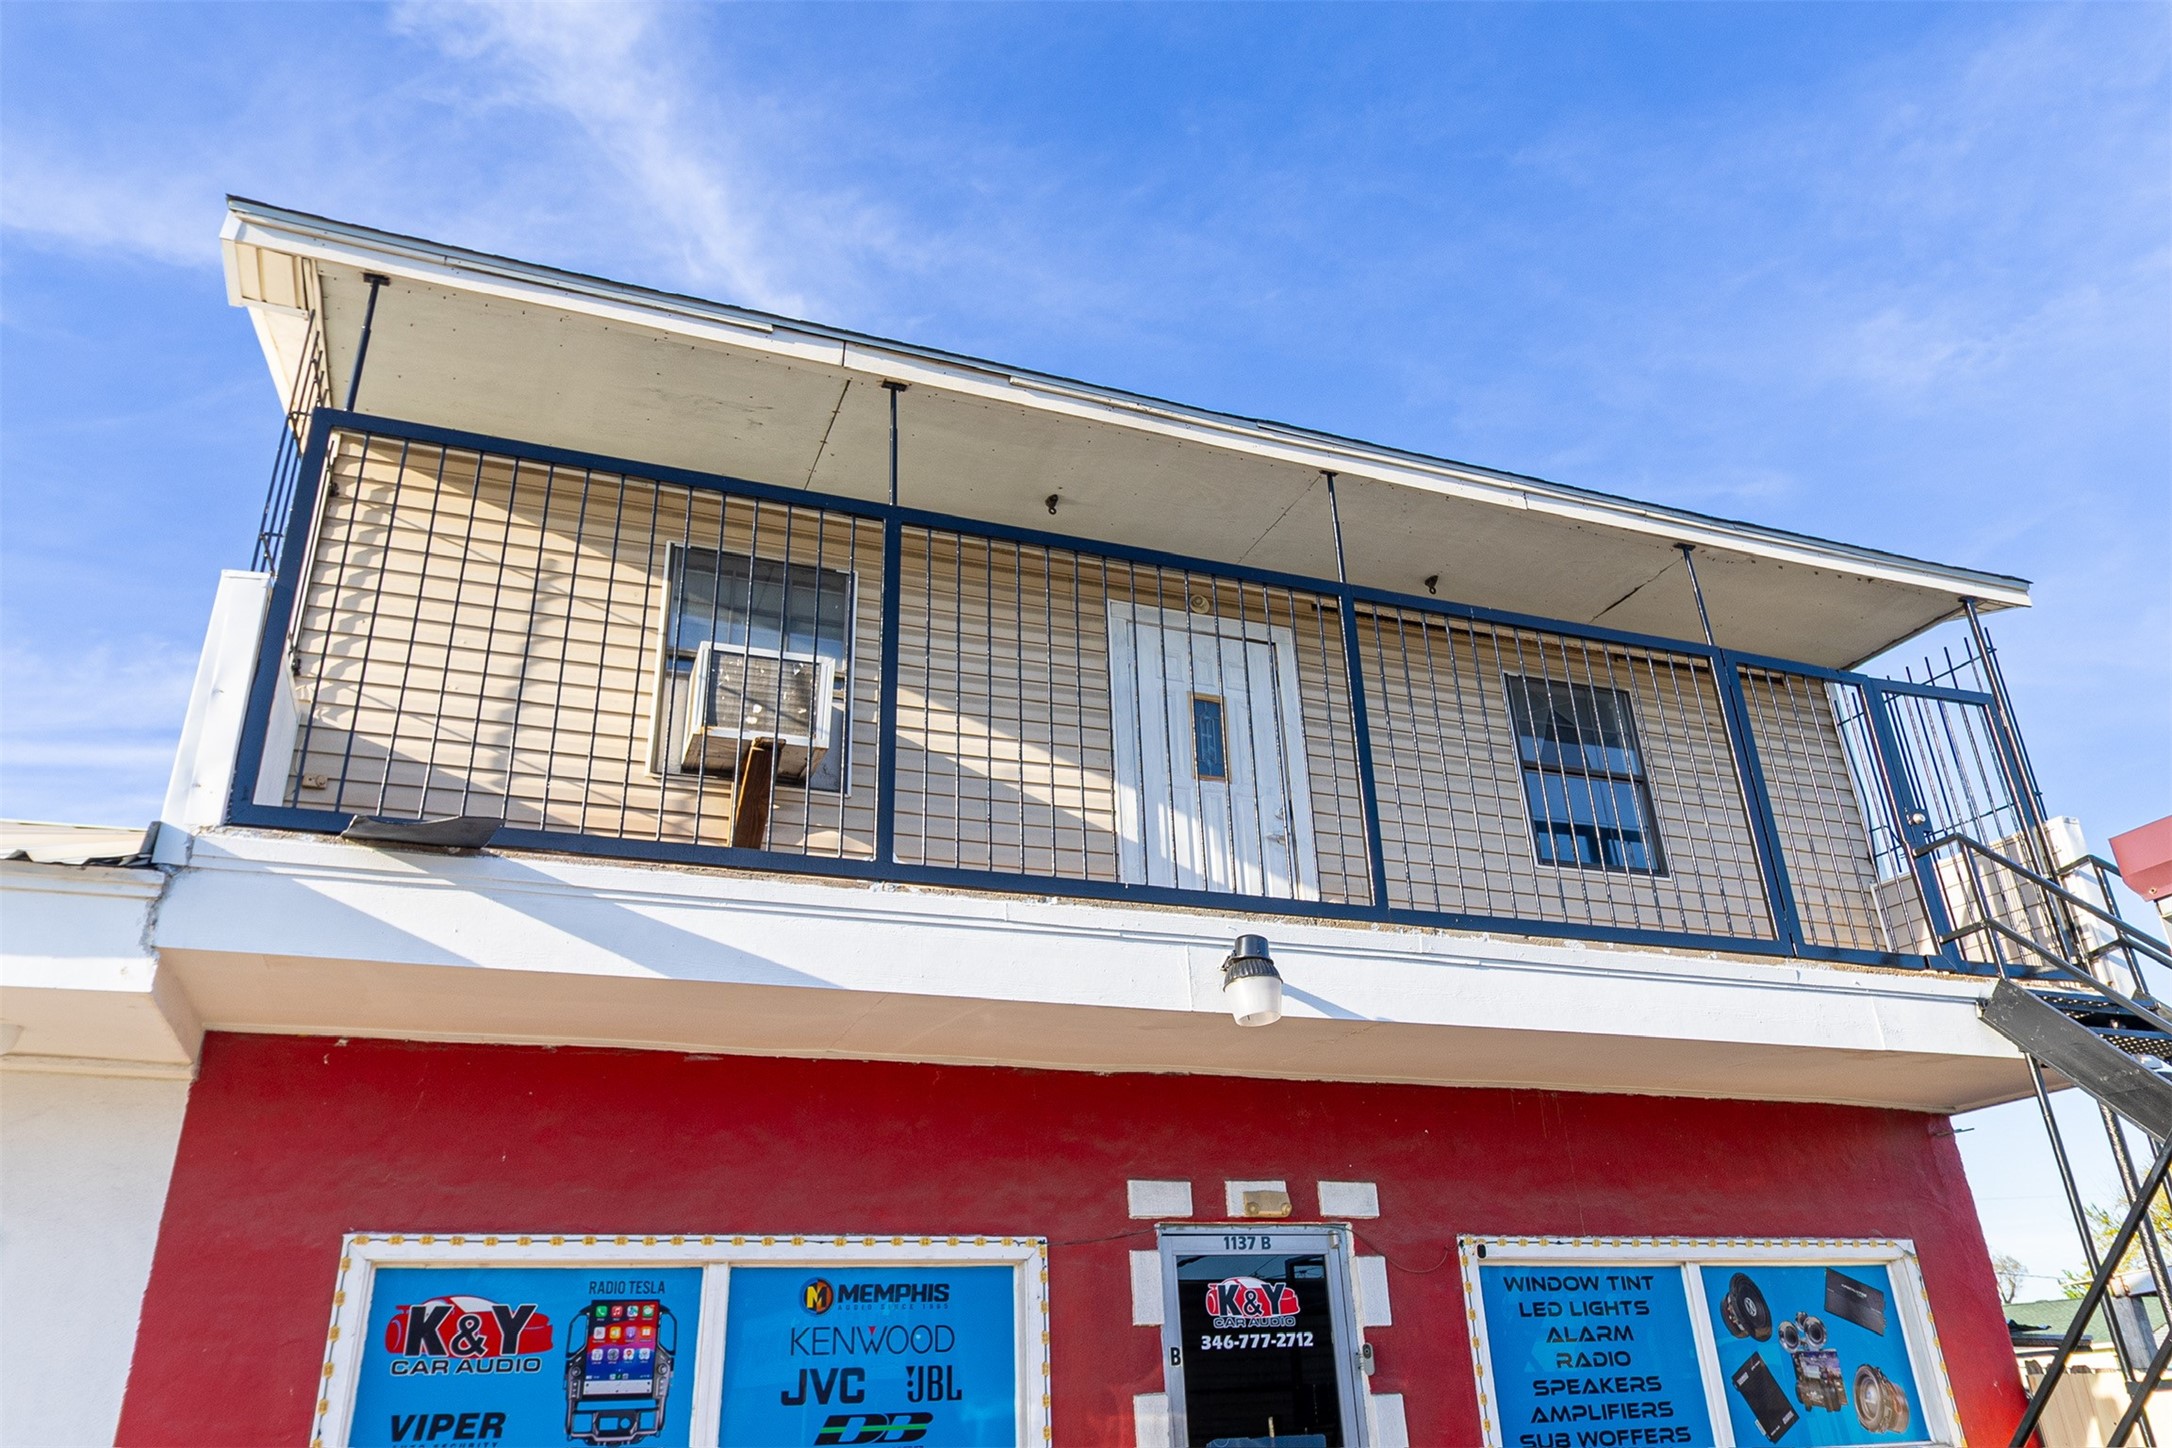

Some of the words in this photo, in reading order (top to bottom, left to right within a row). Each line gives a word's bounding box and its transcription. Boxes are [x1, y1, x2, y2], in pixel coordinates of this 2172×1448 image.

[1223, 1236, 1256, 1250] 1137
[1261, 1236, 1272, 1250] B
[589, 1281, 626, 1295] RADIO
[629, 1281, 666, 1295] TESLA
[838, 1283, 950, 1303] MEMPHIS
[1503, 1276, 1600, 1292] WINDOW
[1606, 1275, 1654, 1291] TINT
[1215, 1282, 1286, 1317] K&Y
[1518, 1302, 1563, 1317] LED
[1569, 1301, 1650, 1316] LIGHTS
[404, 1303, 538, 1357] K&Y
[1213, 1317, 1248, 1328] CAR
[1249, 1316, 1296, 1328] AUDIO
[790, 1325, 955, 1356] KENWOOD
[1201, 1331, 1314, 1350] 346-777-2712
[1546, 1325, 1634, 1343] ALARM
[1170, 1347, 1182, 1366] B
[1556, 1351, 1632, 1368] RADIO
[390, 1358, 454, 1376] CAR
[455, 1358, 541, 1374] AUDIO
[781, 1367, 865, 1406] JVC
[1532, 1376, 1662, 1397] SPEAKERS
[1531, 1401, 1674, 1424] AMPLIFIERS
[391, 1412, 506, 1442] VIPER
[1520, 1431, 1571, 1448] SUB
[1576, 1426, 1692, 1447] WOFFERS
